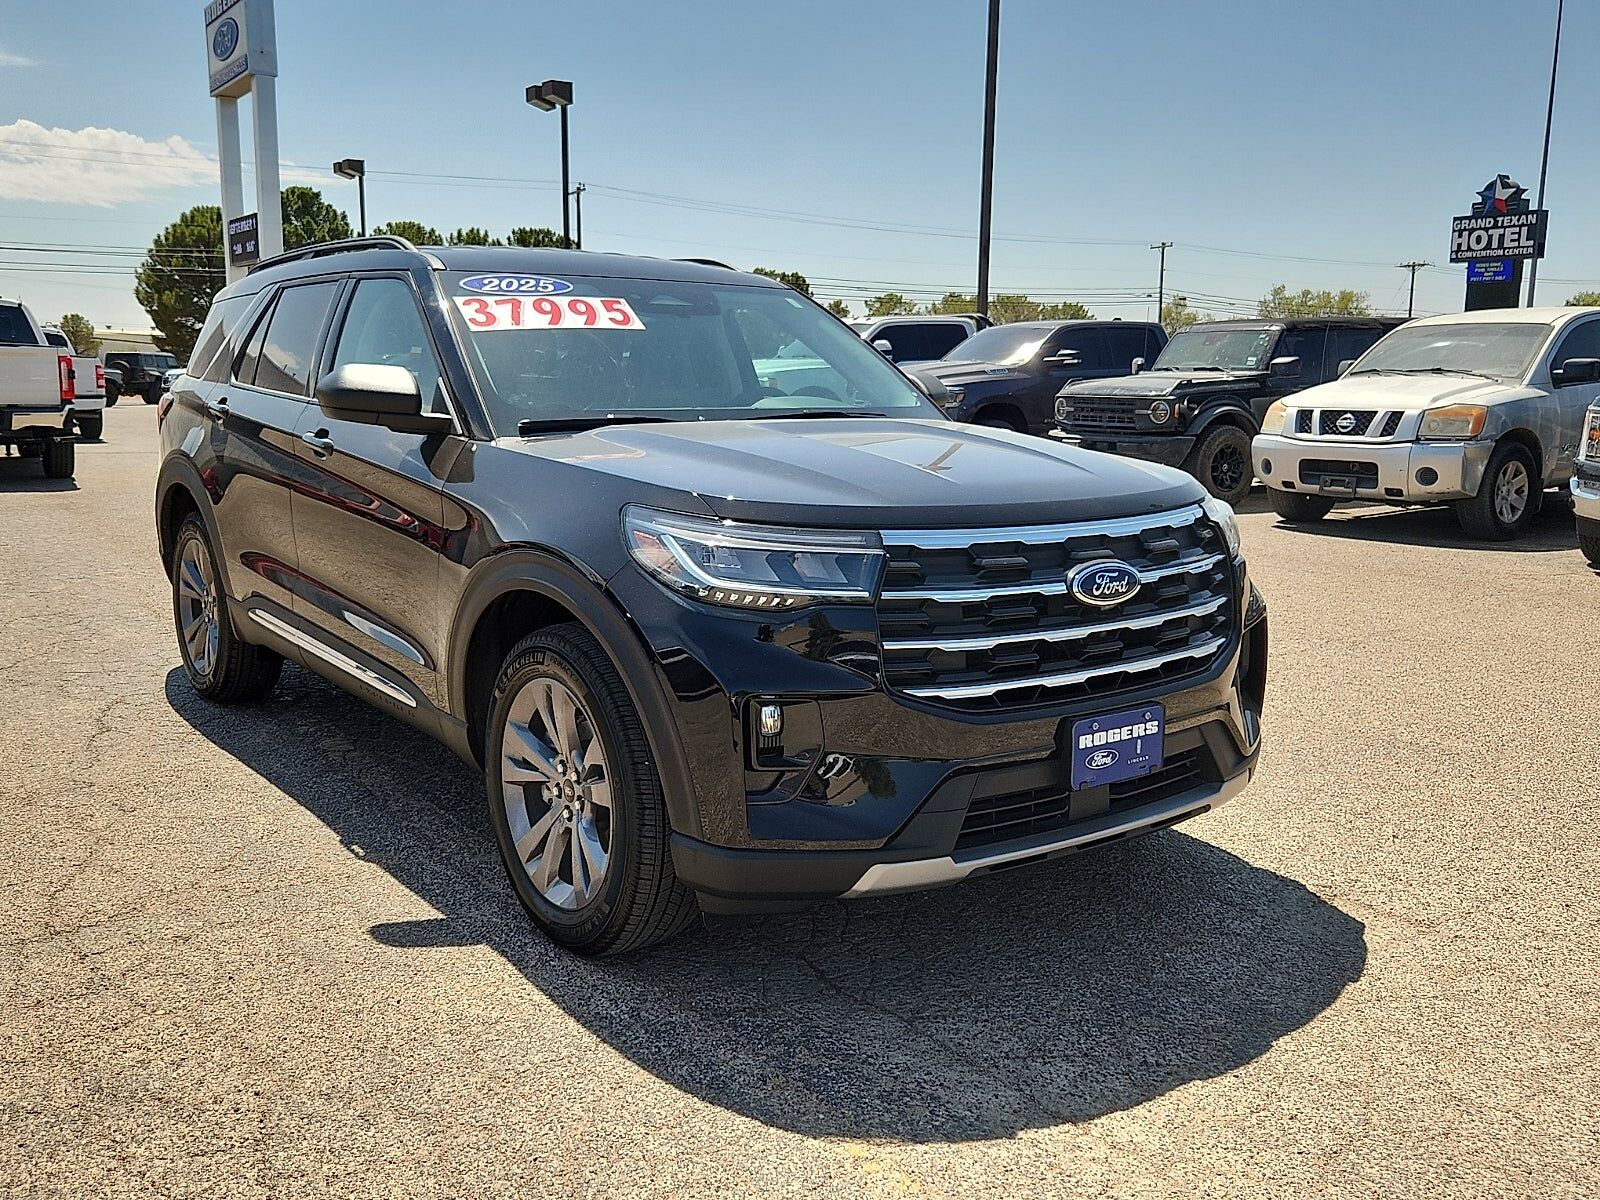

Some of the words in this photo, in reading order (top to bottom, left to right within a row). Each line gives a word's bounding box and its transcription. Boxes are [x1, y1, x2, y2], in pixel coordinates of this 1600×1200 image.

[205, 0, 241, 23] ROGE
[1453, 217, 1495, 231] GRAND
[1496, 213, 1537, 227] TEXAN
[1451, 226, 1534, 252] HOTEL
[1451, 251, 1457, 259] &
[1457, 248, 1504, 259] CONVENTION
[1504, 246, 1534, 256] CENTER
[481, 278, 555, 293] 2025
[462, 297, 633, 328] 37995
[1092, 571, 1129, 596] Ford
[506, 651, 545, 678] MICHELIN
[549, 655, 574, 678] PRIMACY
[1079, 720, 1159, 750] ROGERS
[1091, 751, 1113, 767] Ford
